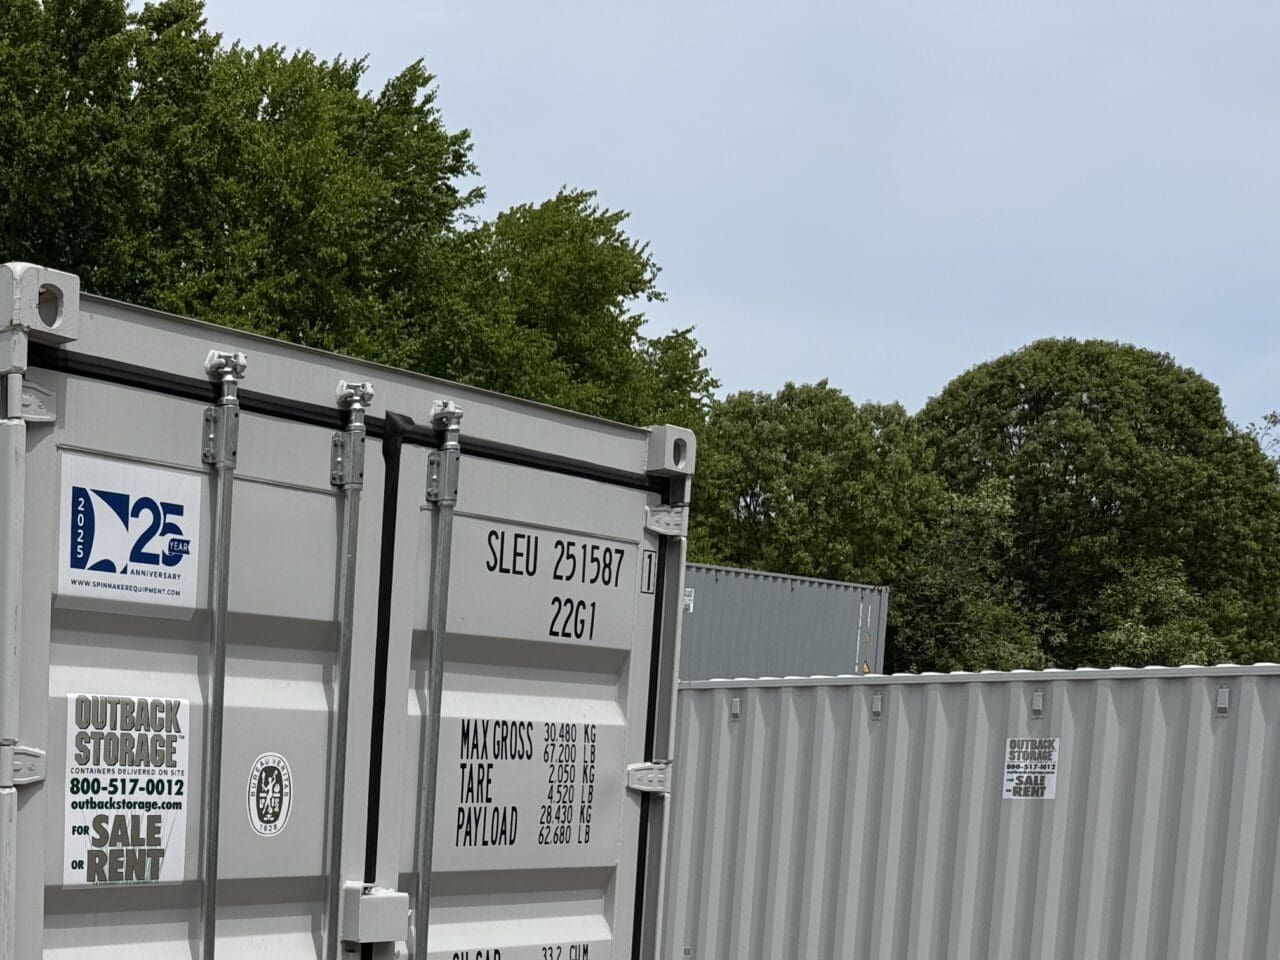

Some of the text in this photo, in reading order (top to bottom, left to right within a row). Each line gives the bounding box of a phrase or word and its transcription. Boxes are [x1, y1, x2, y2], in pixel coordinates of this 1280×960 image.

[76, 497, 85, 558] 2025
[129, 496, 184, 567] 25
[169, 540, 188, 551] YEAR
[486, 530, 653, 591] SLEU 251587 1
[130, 568, 182, 580] ANNIVERSARY
[71, 578, 181, 597] WWW.SPINNAKEREQUIPMENT.COM
[549, 596, 596, 641] 22G1
[74, 694, 182, 733] OUTBACK
[460, 718, 489, 760] MAX
[493, 720, 533, 760] GROSS
[584, 724, 596, 743] KG
[1009, 739, 1056, 750] OUTBACK
[74, 731, 177, 767] STORAGE
[583, 744, 596, 763] LB
[1008, 750, 1053, 761] STORAGE
[70, 767, 116, 776] CONTAINERS
[117, 768, 156, 776] DELIVERED
[170, 769, 185, 777] SITE
[1015, 775, 1046, 786] SALE
[70, 777, 184, 796] 800-517-0012
[460, 763, 493, 804] TARE
[582, 765, 595, 784] KG
[1012, 786, 1046, 797] RENT
[581, 785, 594, 804] LB
[71, 797, 182, 812] outbackstorage.com
[72, 814, 162, 848] FOR SALE
[455, 806, 518, 847] PAYLOAD
[579, 805, 592, 824] KG
[577, 825, 590, 844] LB
[71, 848, 165, 882] OR RENT
